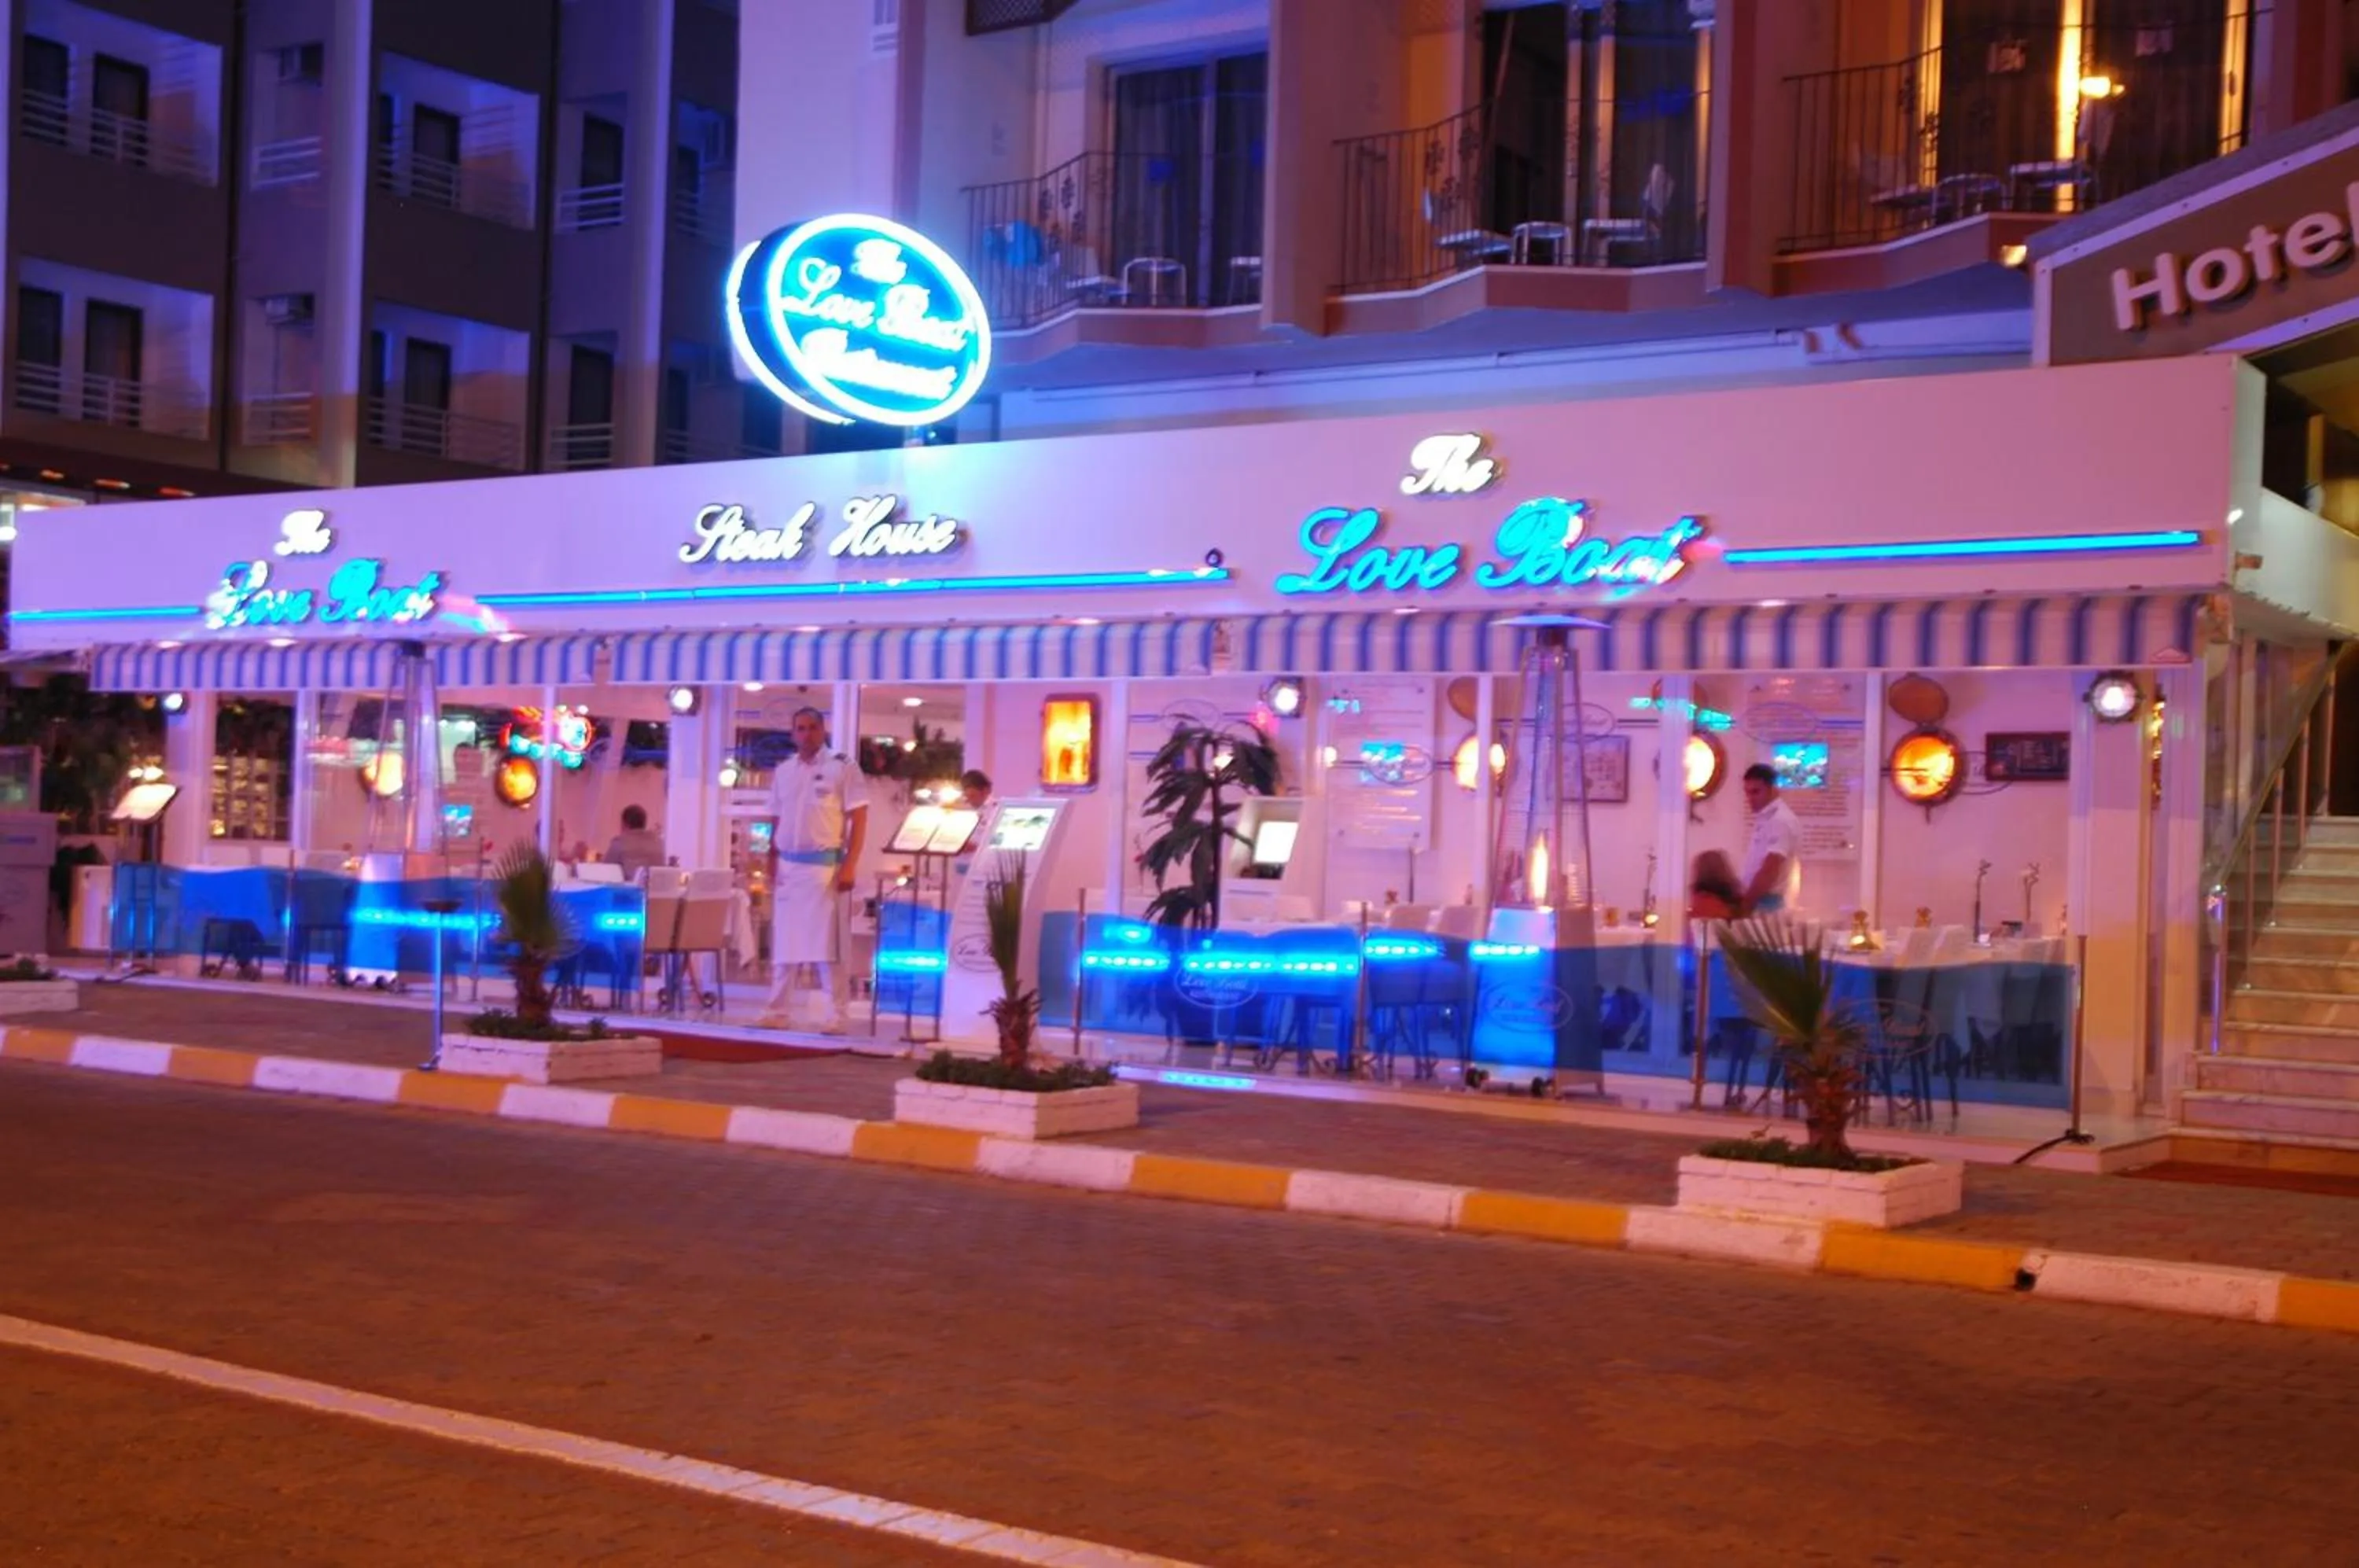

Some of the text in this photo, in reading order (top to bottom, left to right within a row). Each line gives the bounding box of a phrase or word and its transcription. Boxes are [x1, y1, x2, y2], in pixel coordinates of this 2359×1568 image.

[780, 257, 875, 328] Love
[1400, 432, 1496, 495] The
[274, 509, 331, 556] The
[679, 494, 957, 563] Steak House
[1275, 495, 1705, 594] Love Boat
[206, 557, 441, 629] Love Boat
